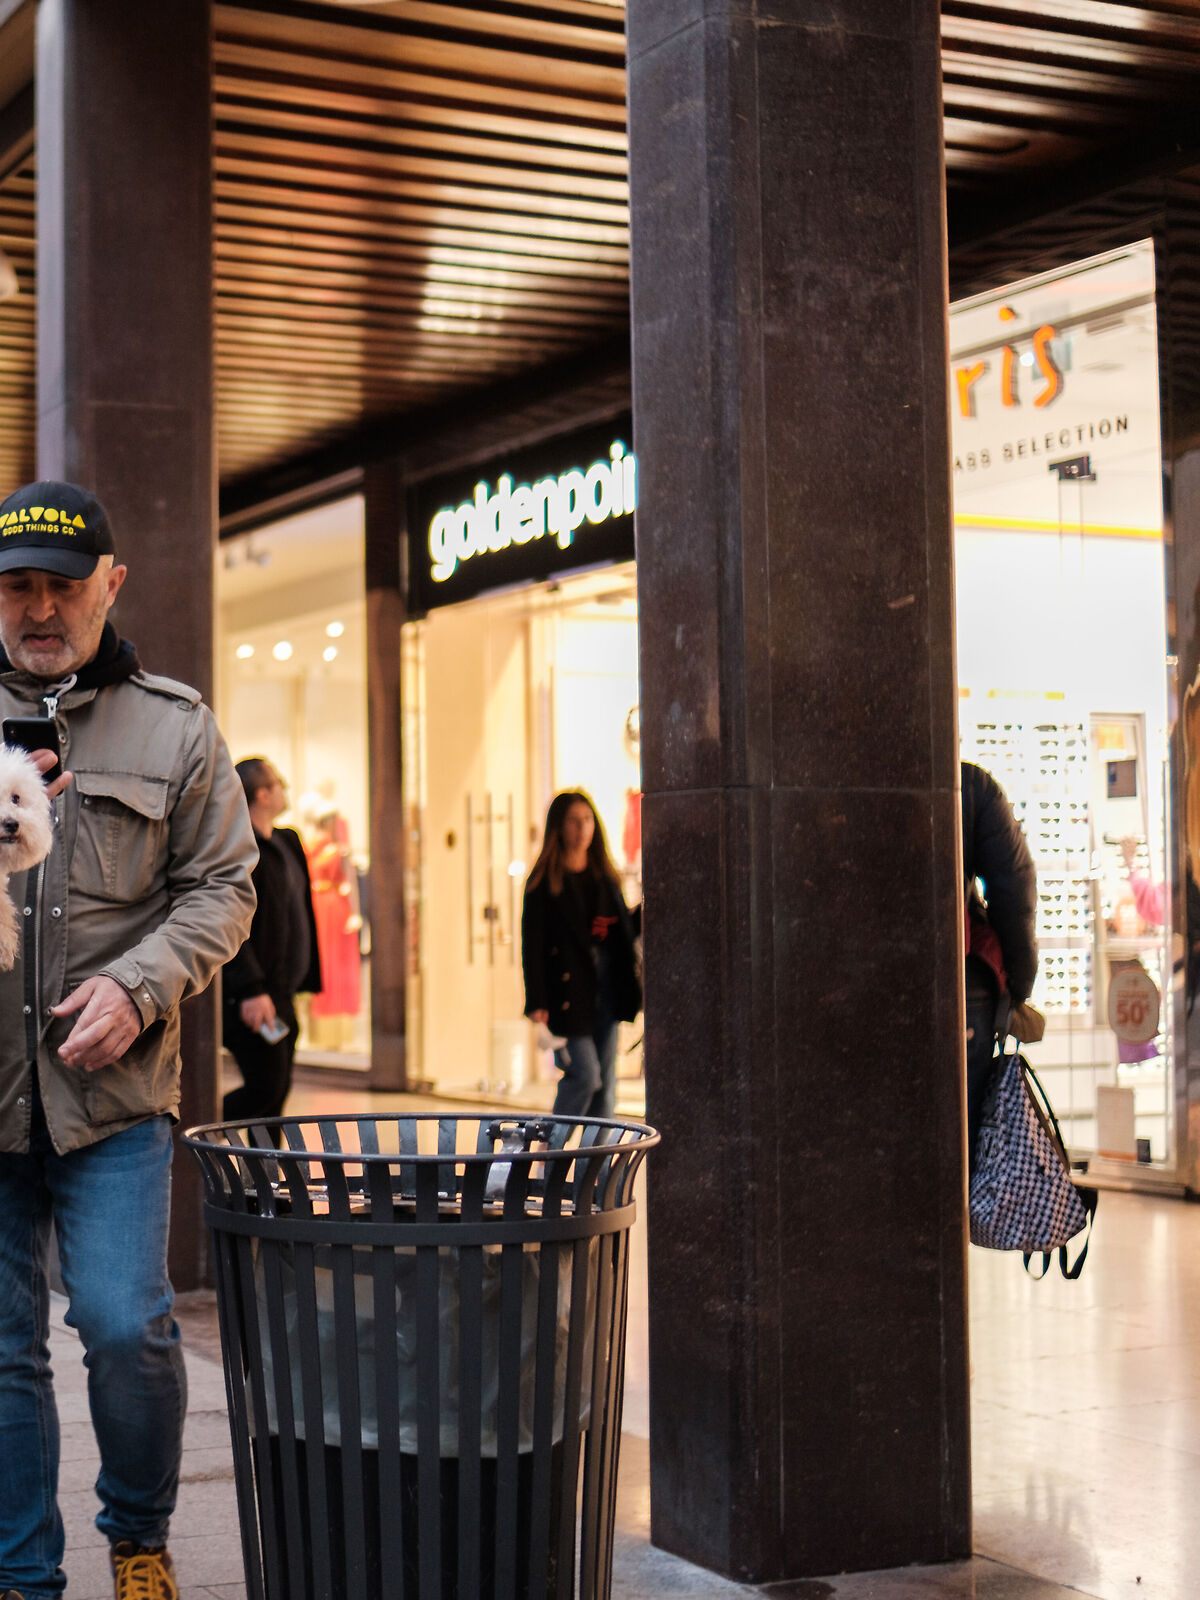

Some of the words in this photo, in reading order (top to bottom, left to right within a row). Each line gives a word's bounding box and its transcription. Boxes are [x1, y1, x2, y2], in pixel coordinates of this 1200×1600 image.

[1003, 415, 1129, 463] SELECTION
[2, 524, 24, 537] GOOD
[25, 523, 60, 534] THINGS
[62, 525, 77, 537] CO.
